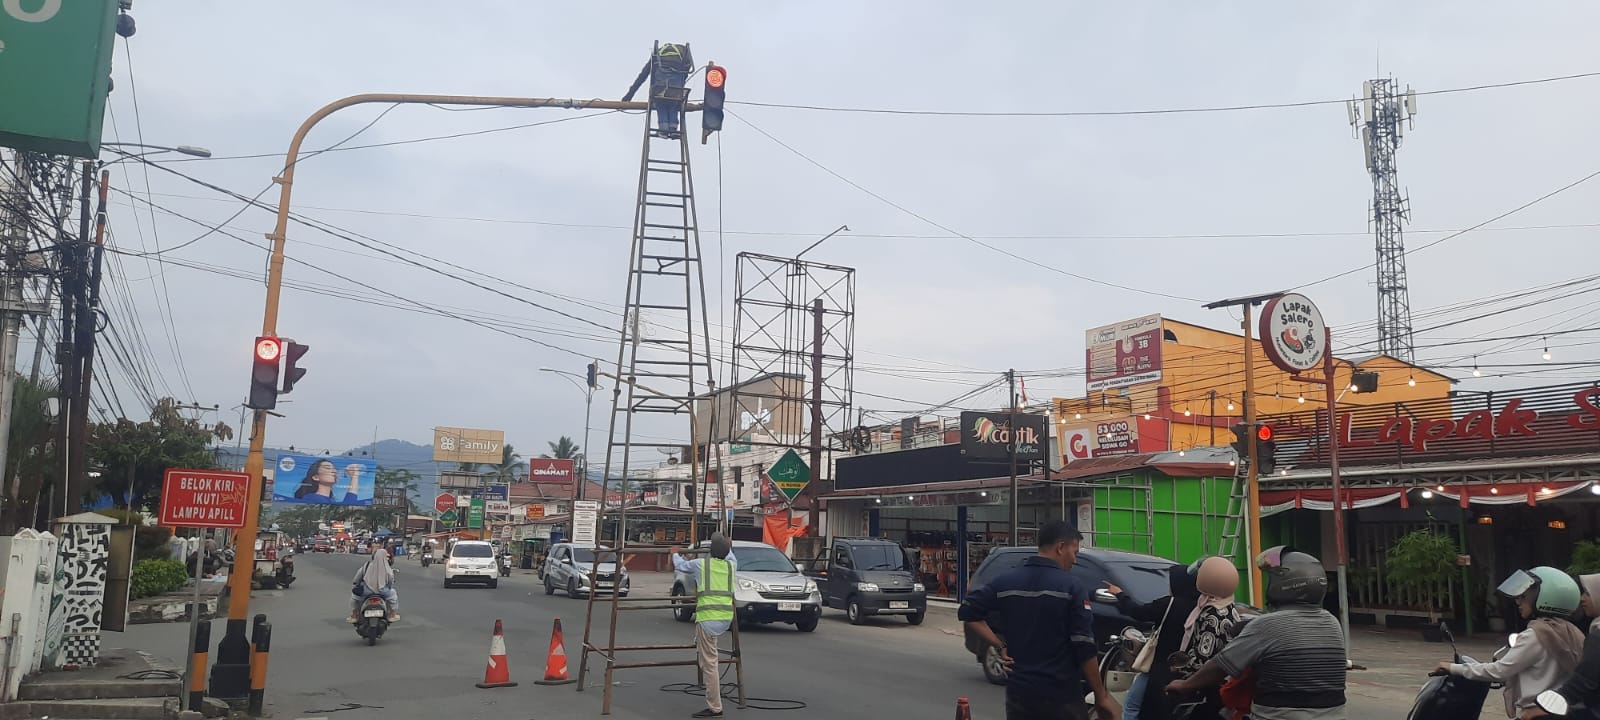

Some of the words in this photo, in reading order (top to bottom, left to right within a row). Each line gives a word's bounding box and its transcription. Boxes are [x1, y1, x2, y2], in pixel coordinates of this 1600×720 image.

[1282, 302, 1312, 316] Lapak
[1281, 312, 1314, 328] Salero
[1338, 398, 1540, 453] Lapak
[991, 427, 1040, 444] catik
[180, 478, 213, 491] BELOK
[214, 479, 235, 492] KIRI
[193, 492, 220, 505] IKUTI
[172, 506, 206, 519] LAMPU
[207, 508, 235, 521] APILL
